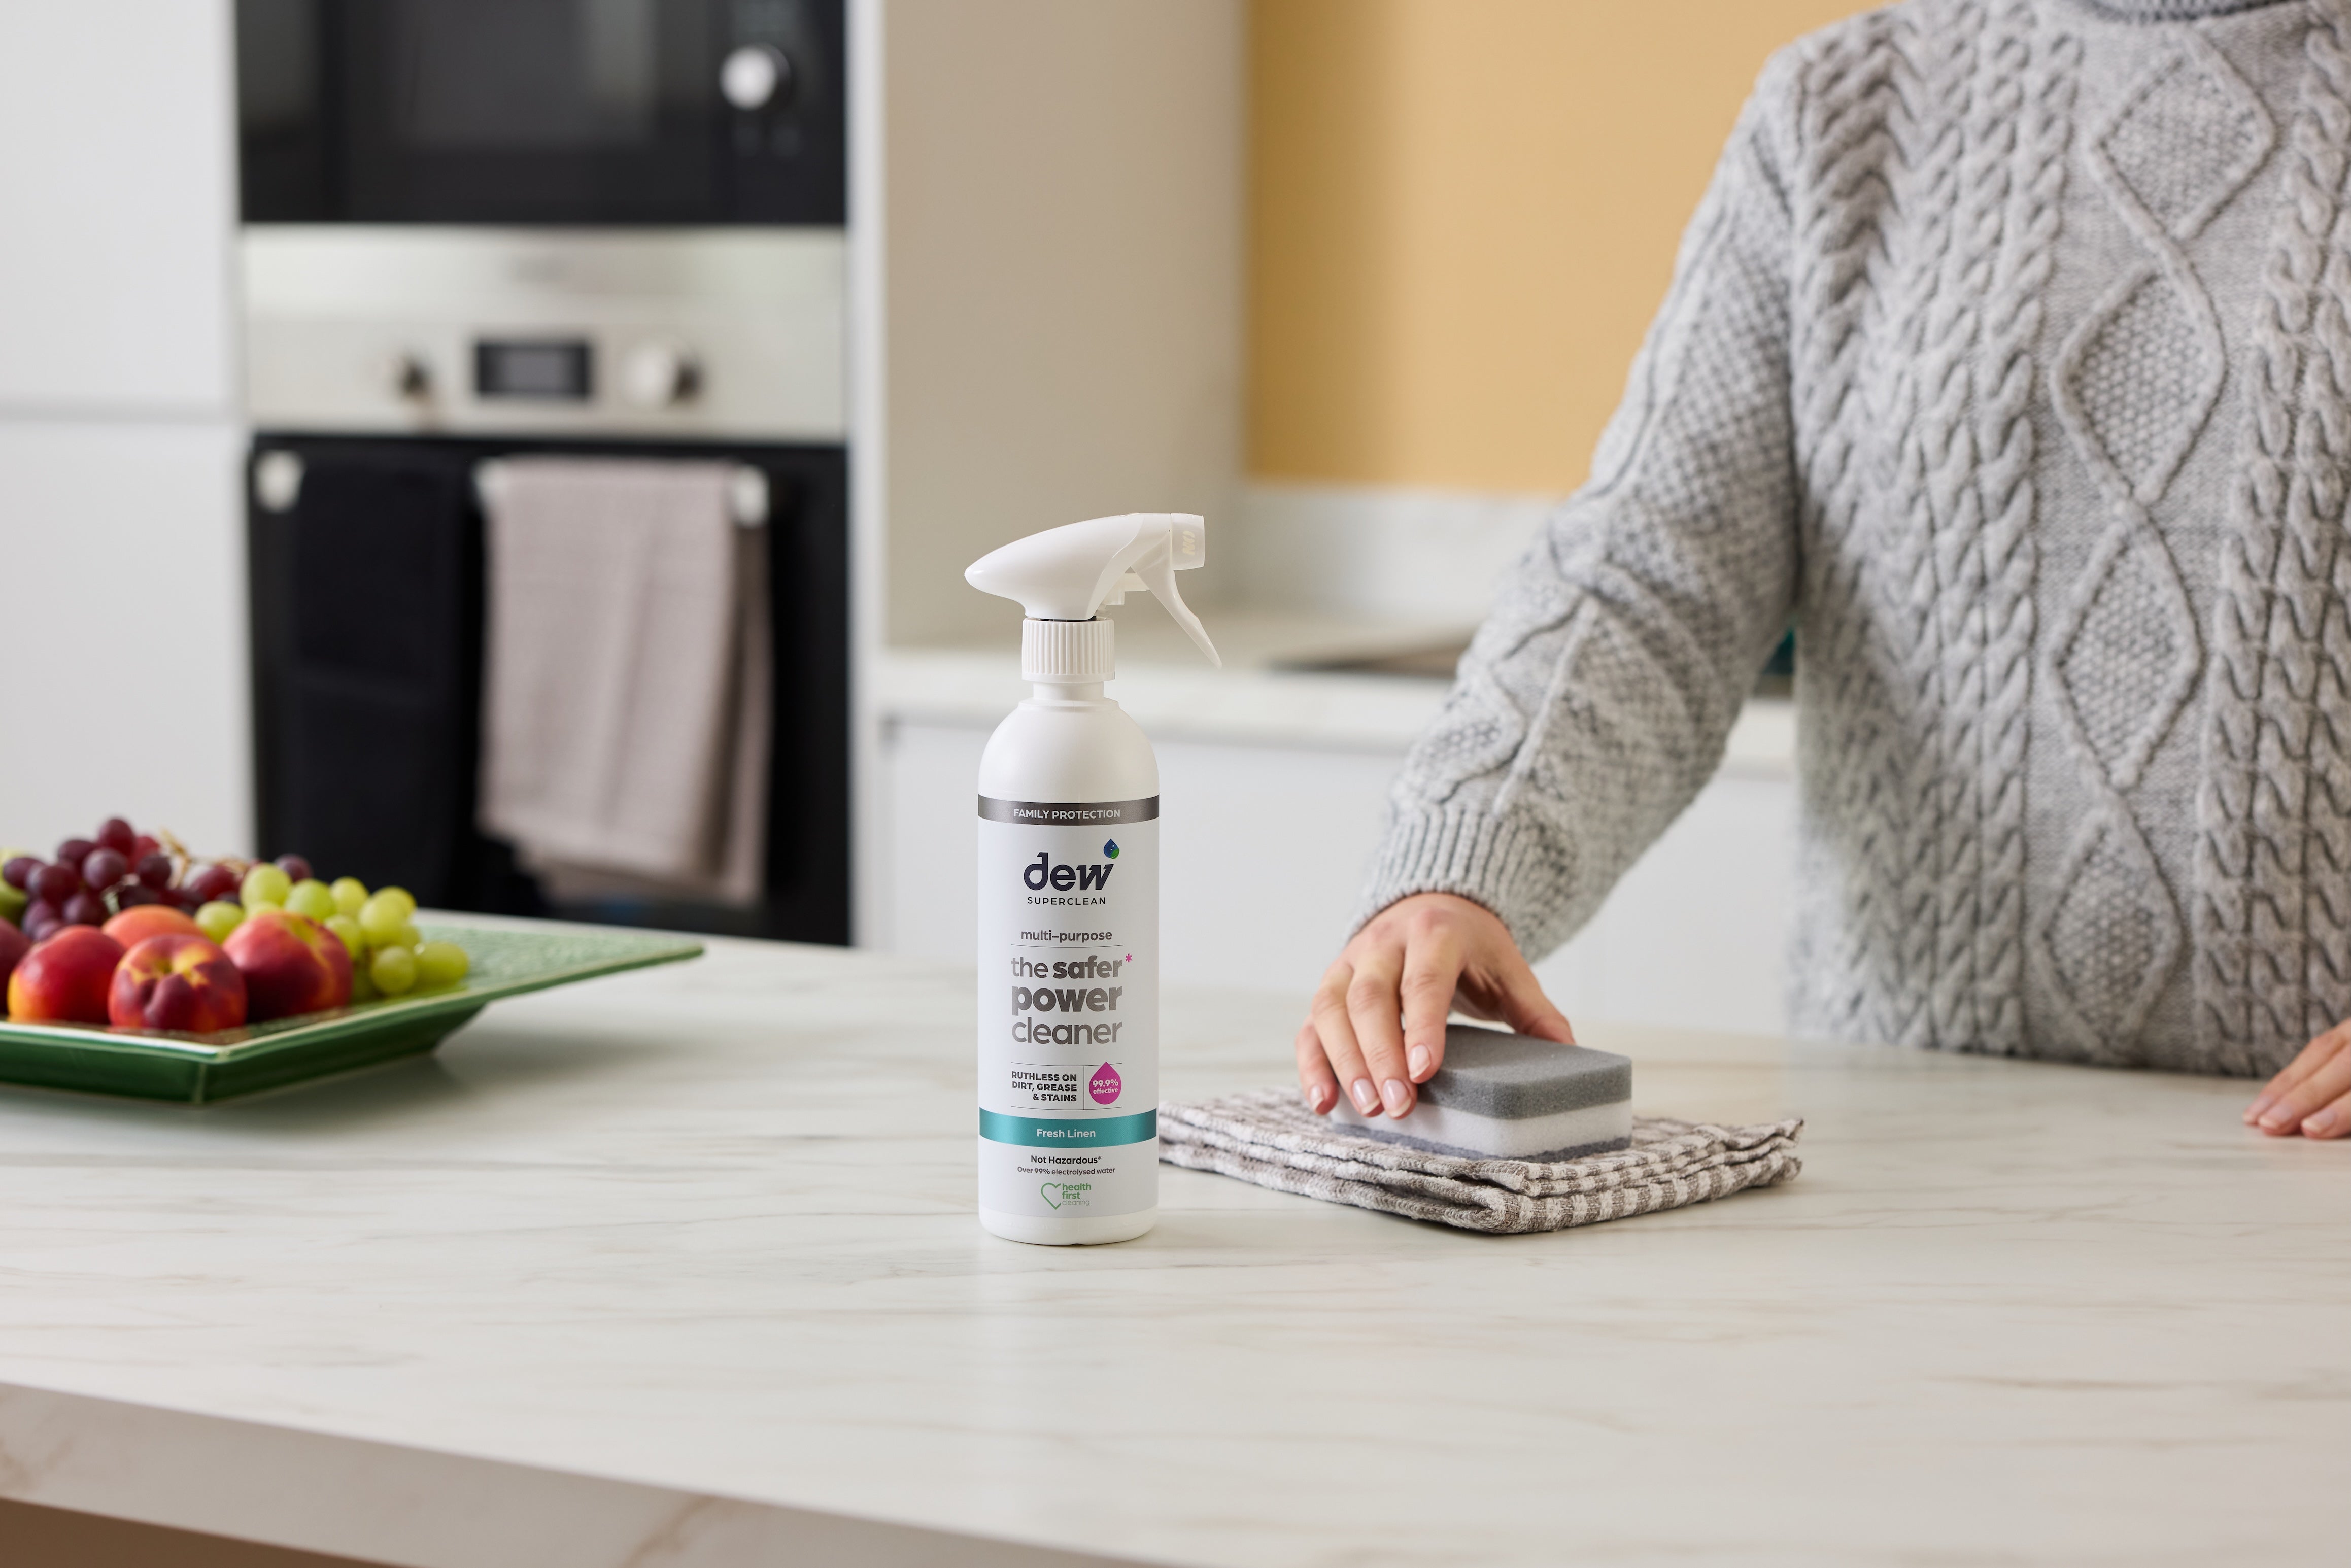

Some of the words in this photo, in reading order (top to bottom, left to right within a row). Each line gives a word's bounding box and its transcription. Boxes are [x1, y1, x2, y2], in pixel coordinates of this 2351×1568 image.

[1013, 809, 1049, 819] FAMILY
[1052, 809, 1120, 819] PROTECTION
[1024, 852, 1114, 891] dew
[1027, 897, 1106, 905] SUPERCLEAN
[1021, 930, 1112, 943] multi-purpose
[1011, 957, 1048, 978] the
[1012, 986, 1122, 1016] power
[1012, 1017, 1122, 1045] cleaner
[1011, 1071, 1060, 1081] RUTHLESS
[1012, 1081, 1034, 1092] DIRT,
[1037, 1083, 1077, 1092] GREASE
[1092, 1079, 1119, 1087] 99.9%
[1041, 1094, 1077, 1102] STAINS
[1036, 1129, 1065, 1138] Fresh
[1067, 1130, 1096, 1138] Linen
